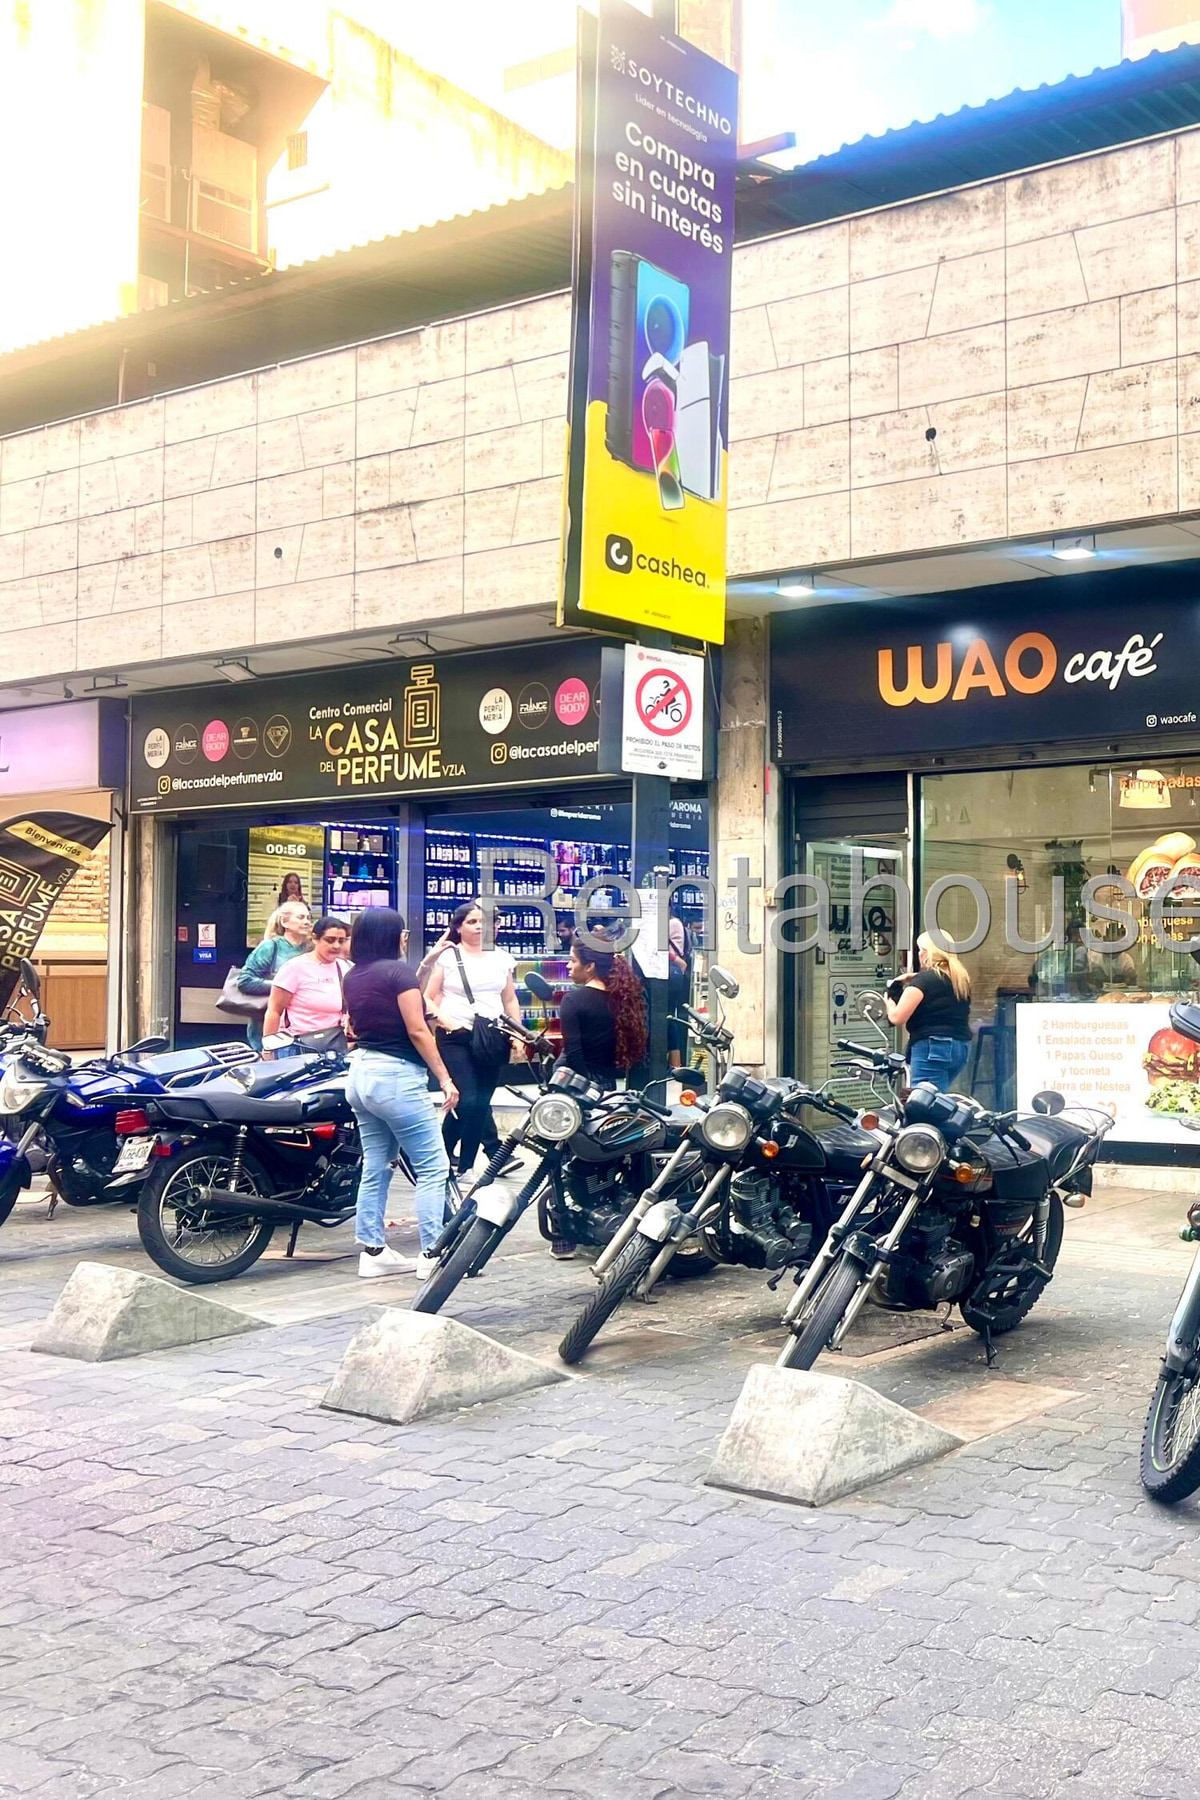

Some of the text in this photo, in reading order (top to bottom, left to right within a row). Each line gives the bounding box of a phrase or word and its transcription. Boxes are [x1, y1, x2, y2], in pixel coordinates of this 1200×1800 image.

[628, 60, 731, 135] SOYTECHNO
[625, 122, 715, 190] Compra
[616, 151, 722, 223] en cuotas
[612, 179, 723, 254] sin interés
[877, 632, 1164, 707] WAO café
[560, 691, 587, 704] DEAR
[309, 698, 392, 720] Centro Comercial
[560, 703, 587, 715] BODY
[1160, 711, 1197, 725] waocafe
[206, 732, 227, 743] DEAR
[309, 717, 399, 757] LA CASA
[626, 735, 653, 746] PROHIBIDO
[662, 741, 675, 749] PASO
[206, 742, 227, 752] BODY
[320, 749, 467, 786] DEL PERFUME VZLA
[171, 768, 283, 791] @lacasadelperfumevzla
[669, 801, 703, 814] 'AROMA
[25, 826, 82, 858] Bienvenidos
[265, 843, 307, 856] 00:56
[55, 867, 73, 886] VZLA
[1, 880, 60, 973] PERFUME
[1042, 1019, 1129, 1032] 2 Hamburguesas
[1045, 1034, 1092, 1046] Ensalada
[1095, 1036, 1123, 1046] cesar
[1127, 1035, 1136, 1045] M
[1055, 1050, 1086, 1063] Papas
[1089, 1050, 1123, 1062] Queso
[1069, 1065, 1111, 1077] tocineta
[1050, 1080, 1077, 1092] Jarra
[1079, 1080, 1092, 1091] de
[1095, 1080, 1131, 1092] Nestea
